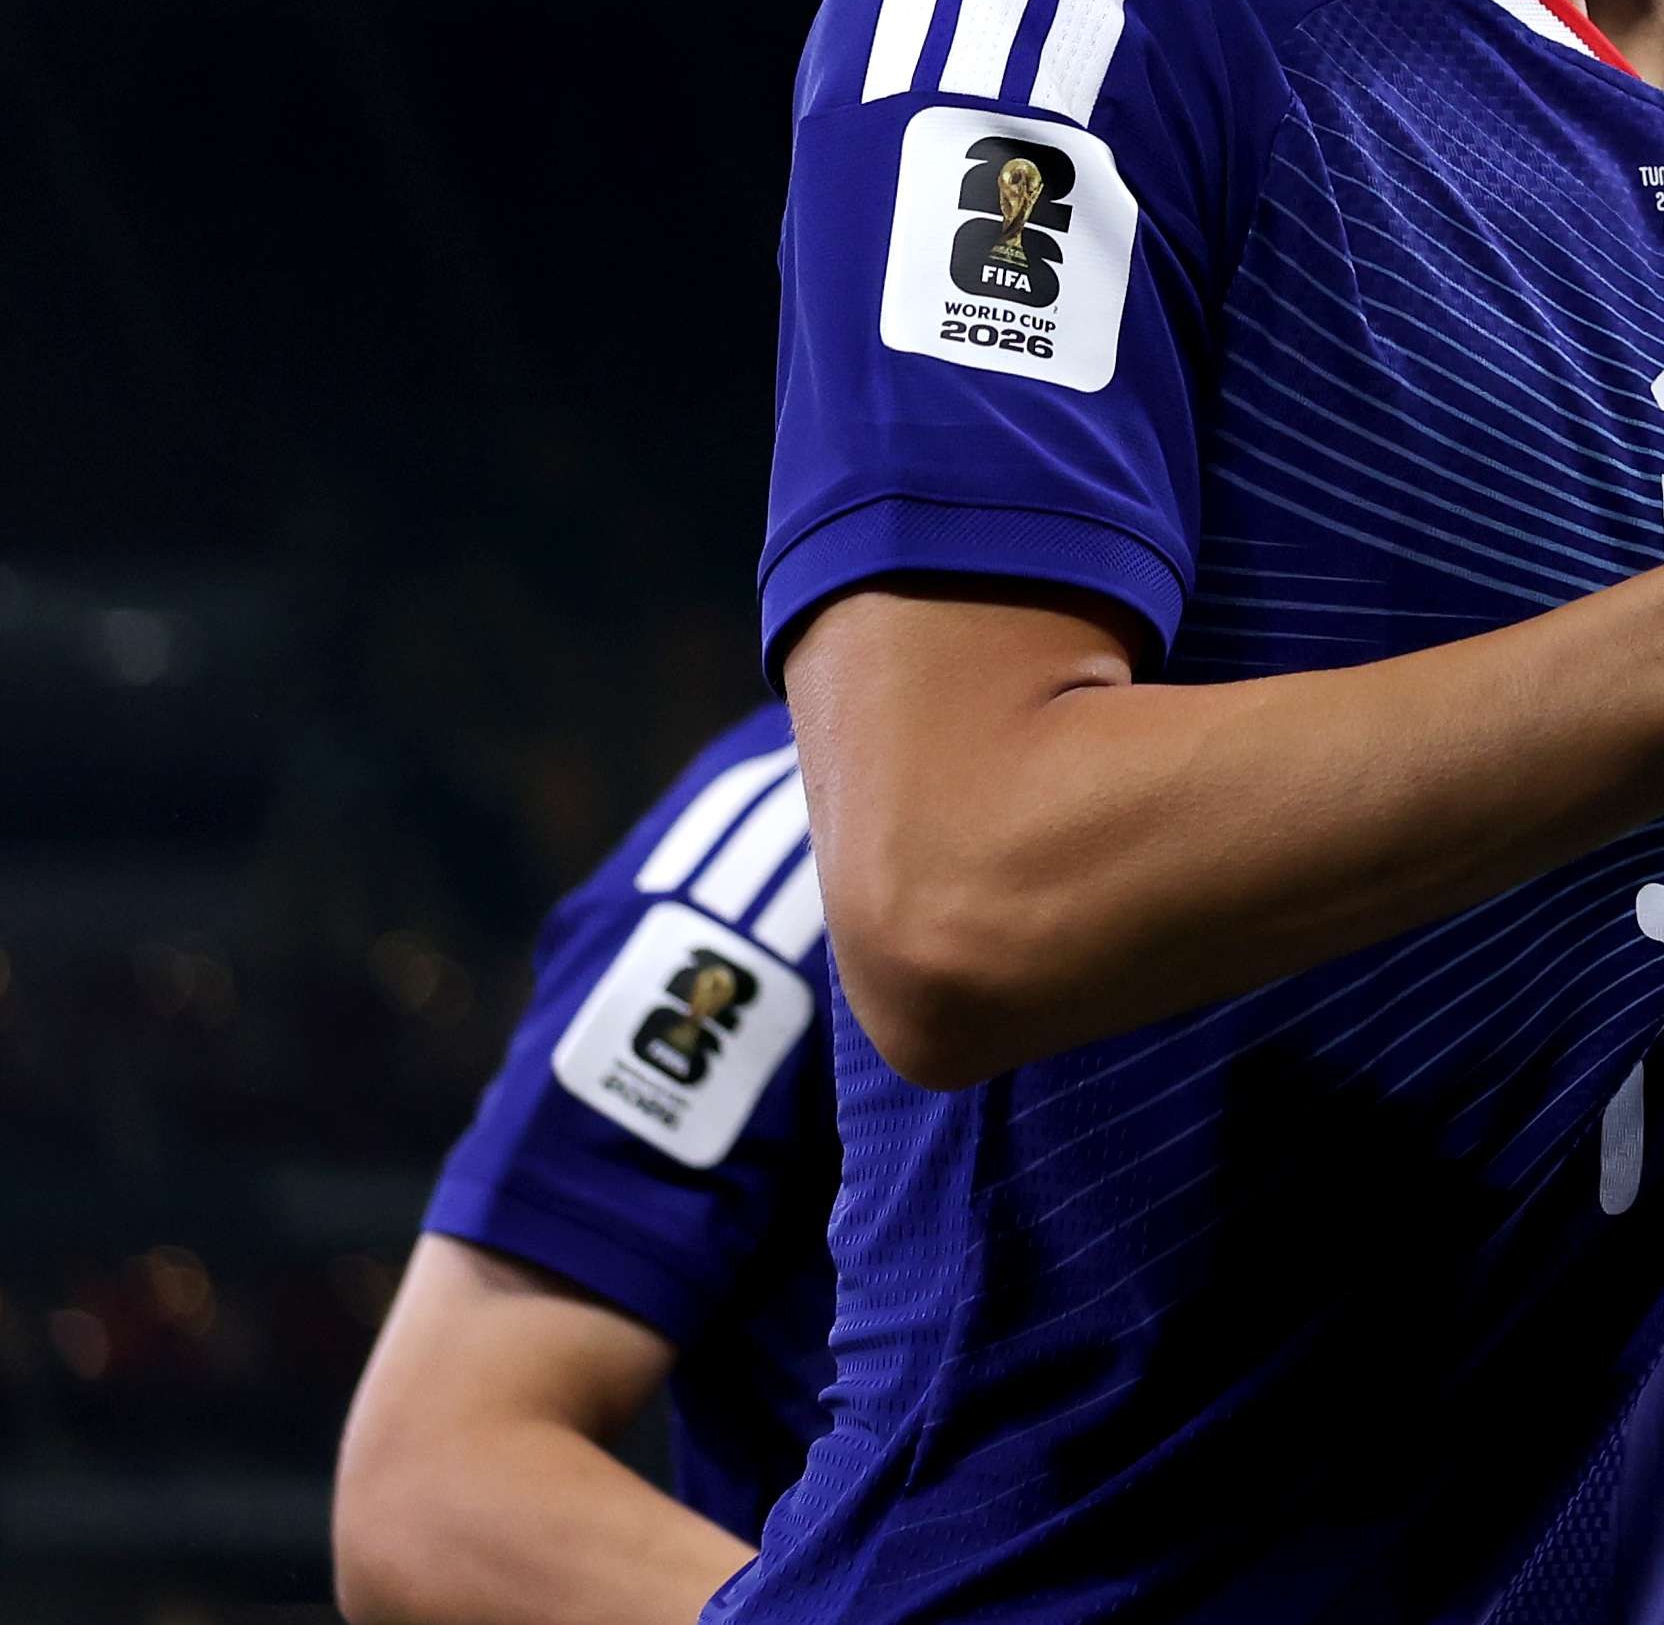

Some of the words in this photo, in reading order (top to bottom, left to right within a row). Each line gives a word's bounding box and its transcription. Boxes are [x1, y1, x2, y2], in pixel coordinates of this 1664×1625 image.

[980, 264, 1032, 293] FIFA
[944, 300, 1016, 323] WORLD
[1019, 313, 1057, 334] CUP
[939, 320, 1055, 360] 2026
